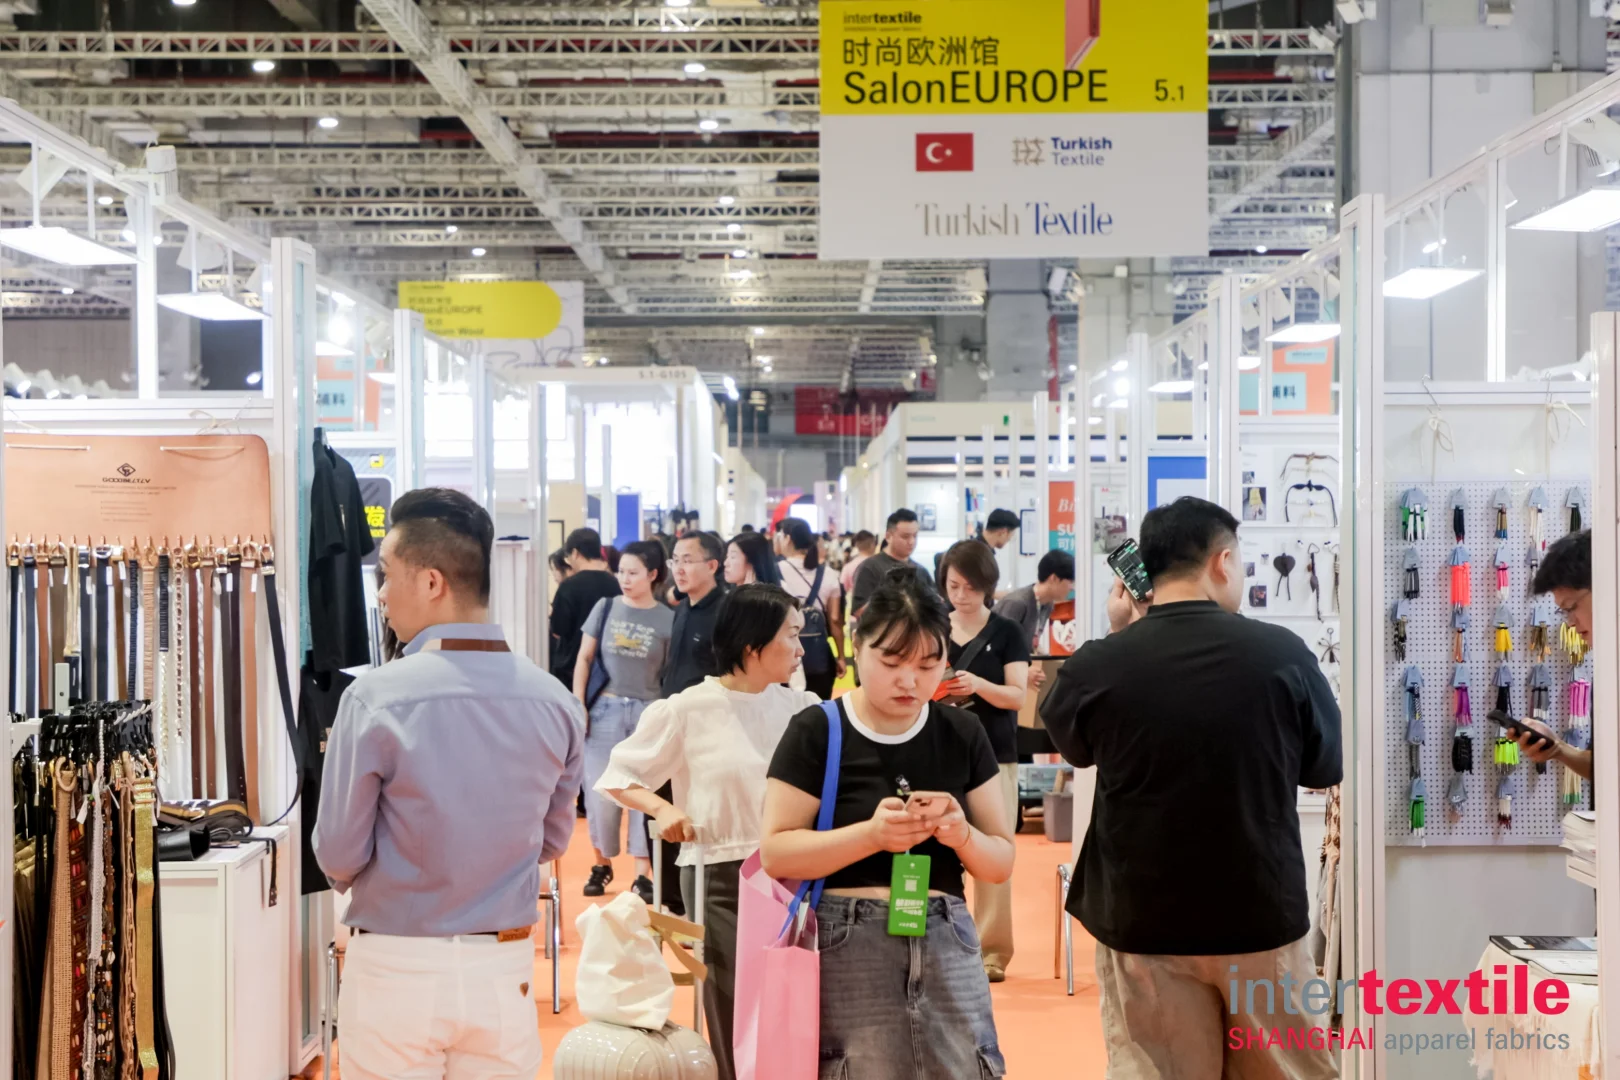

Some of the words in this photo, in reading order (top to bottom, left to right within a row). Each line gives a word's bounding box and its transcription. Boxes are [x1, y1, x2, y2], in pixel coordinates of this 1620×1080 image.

[843, 11, 922, 24] intertextile
[843, 37, 1000, 66] 时尚欧洲馆
[844, 69, 1108, 104] SalonEUROPE
[1154, 79, 1185, 102] 5.1
[1050, 136, 1112, 150] Turkish
[1051, 152, 1105, 166] Textile
[915, 203, 1020, 237] Turkish
[1025, 202, 1113, 236] Textile
